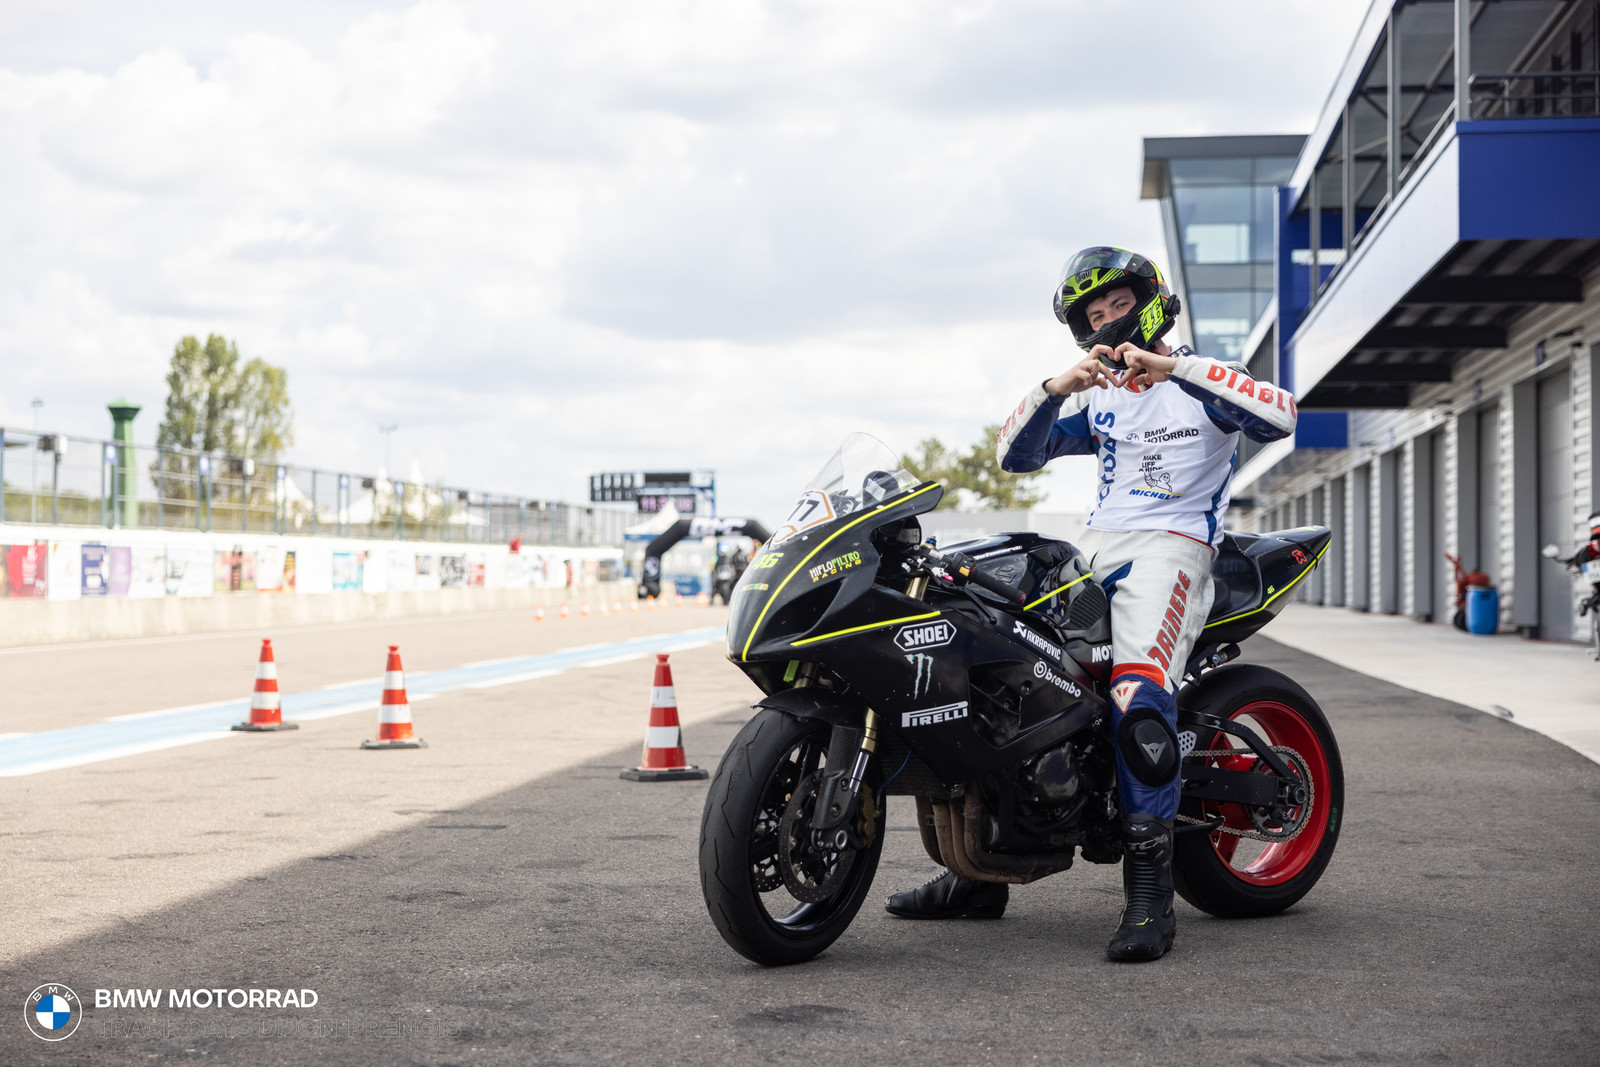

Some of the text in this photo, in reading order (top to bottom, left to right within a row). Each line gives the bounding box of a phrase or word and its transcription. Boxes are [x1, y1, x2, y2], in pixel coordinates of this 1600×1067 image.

[1140, 297, 1164, 333] 46
[1207, 364, 1298, 420] DIABLO
[1144, 426, 1168, 439] BMW
[752, 552, 785, 570] 46
[809, 550, 861, 579] HIFLOFILTRO
[812, 558, 863, 583] RACING
[903, 624, 949, 647] SHOEI
[1091, 644, 1114, 663] MOT
[1044, 668, 1082, 698] brembo
[901, 700, 969, 728] PIRELLI
